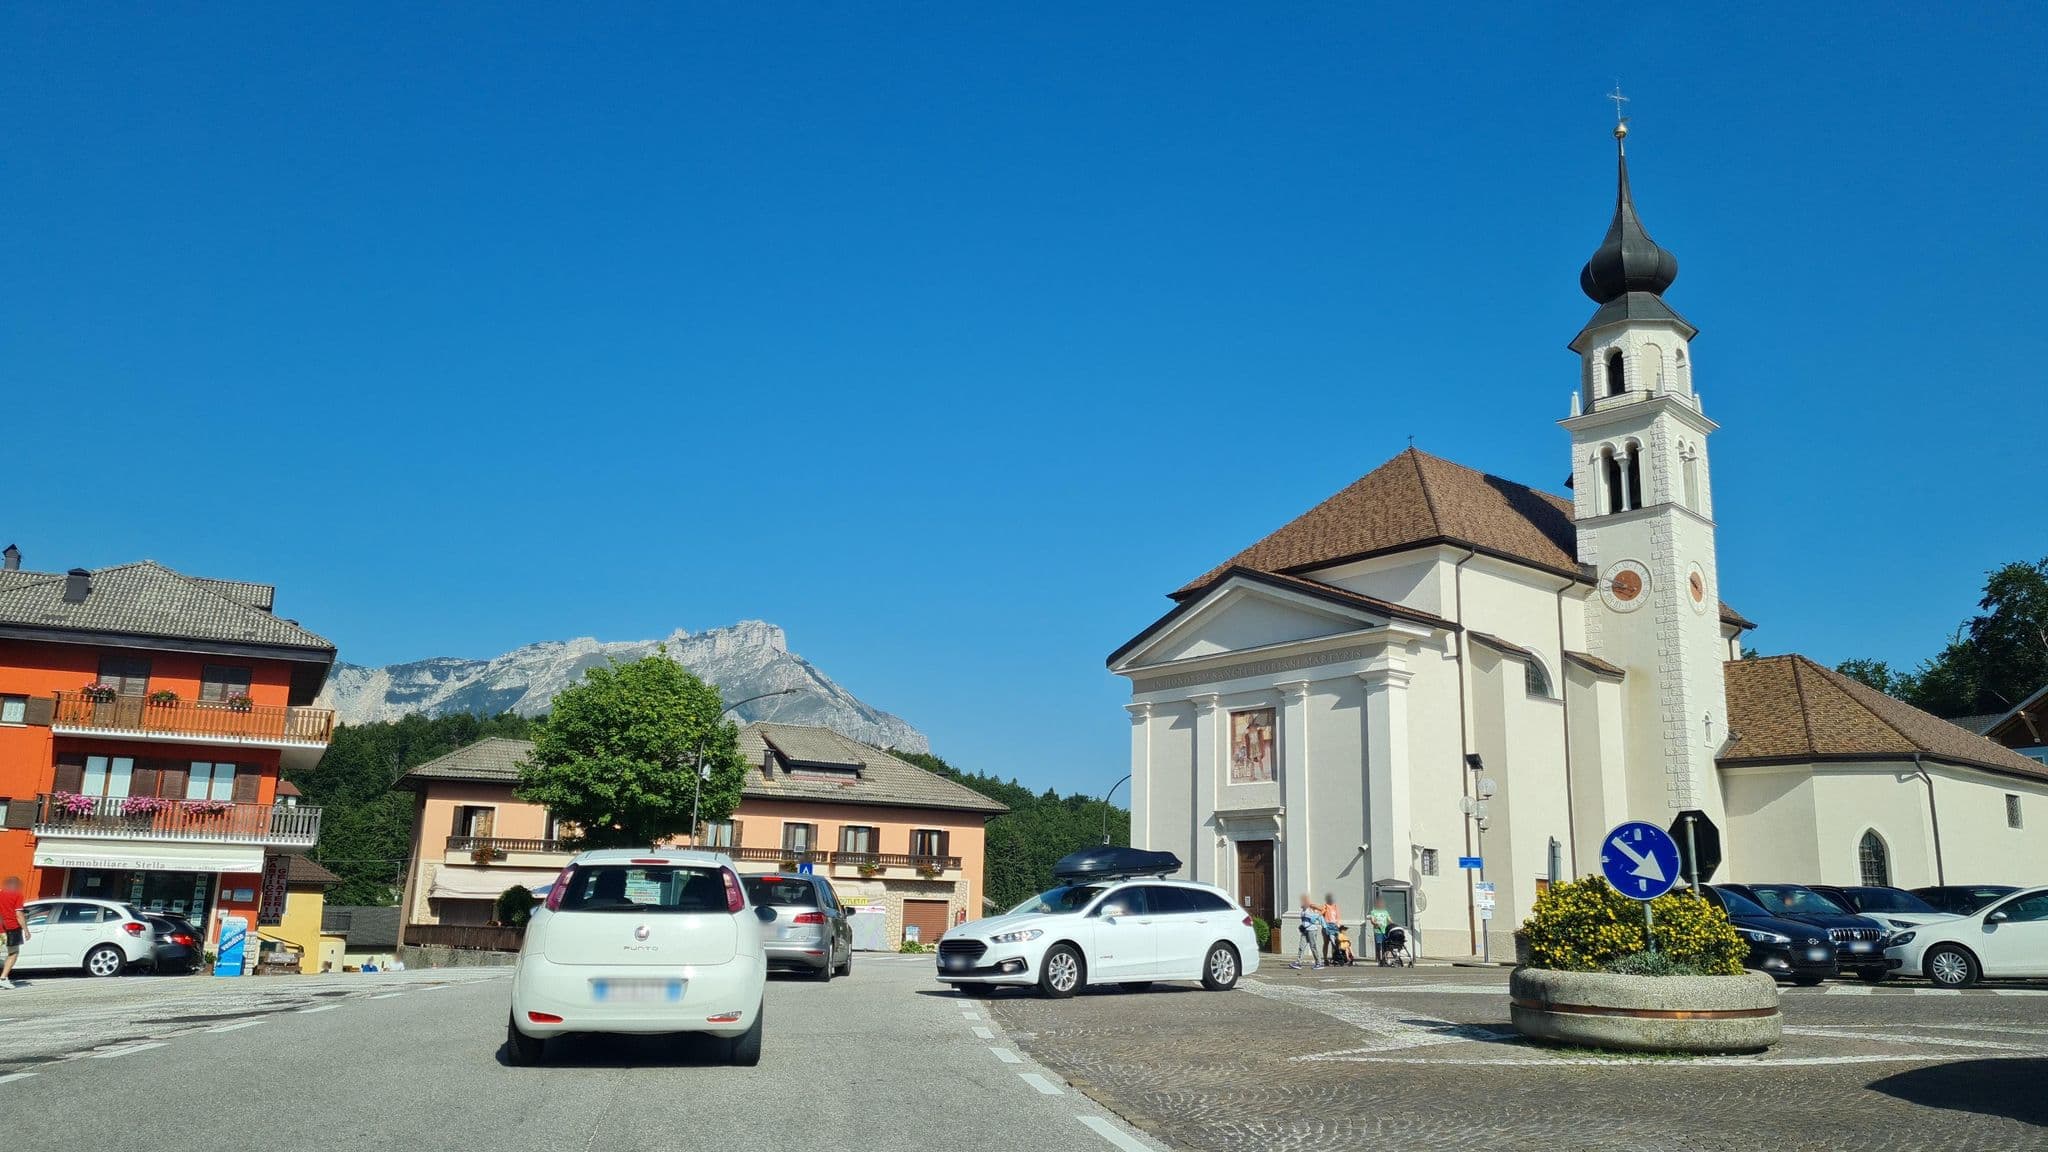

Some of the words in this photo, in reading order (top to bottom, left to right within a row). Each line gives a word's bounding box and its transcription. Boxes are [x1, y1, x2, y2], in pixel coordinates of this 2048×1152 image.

[60, 858, 128, 869] Immobiliare
[135, 861, 166, 870] Stella
[261, 857, 279, 918] PASTICCERIA
[271, 868, 288, 918] GELATERIA
